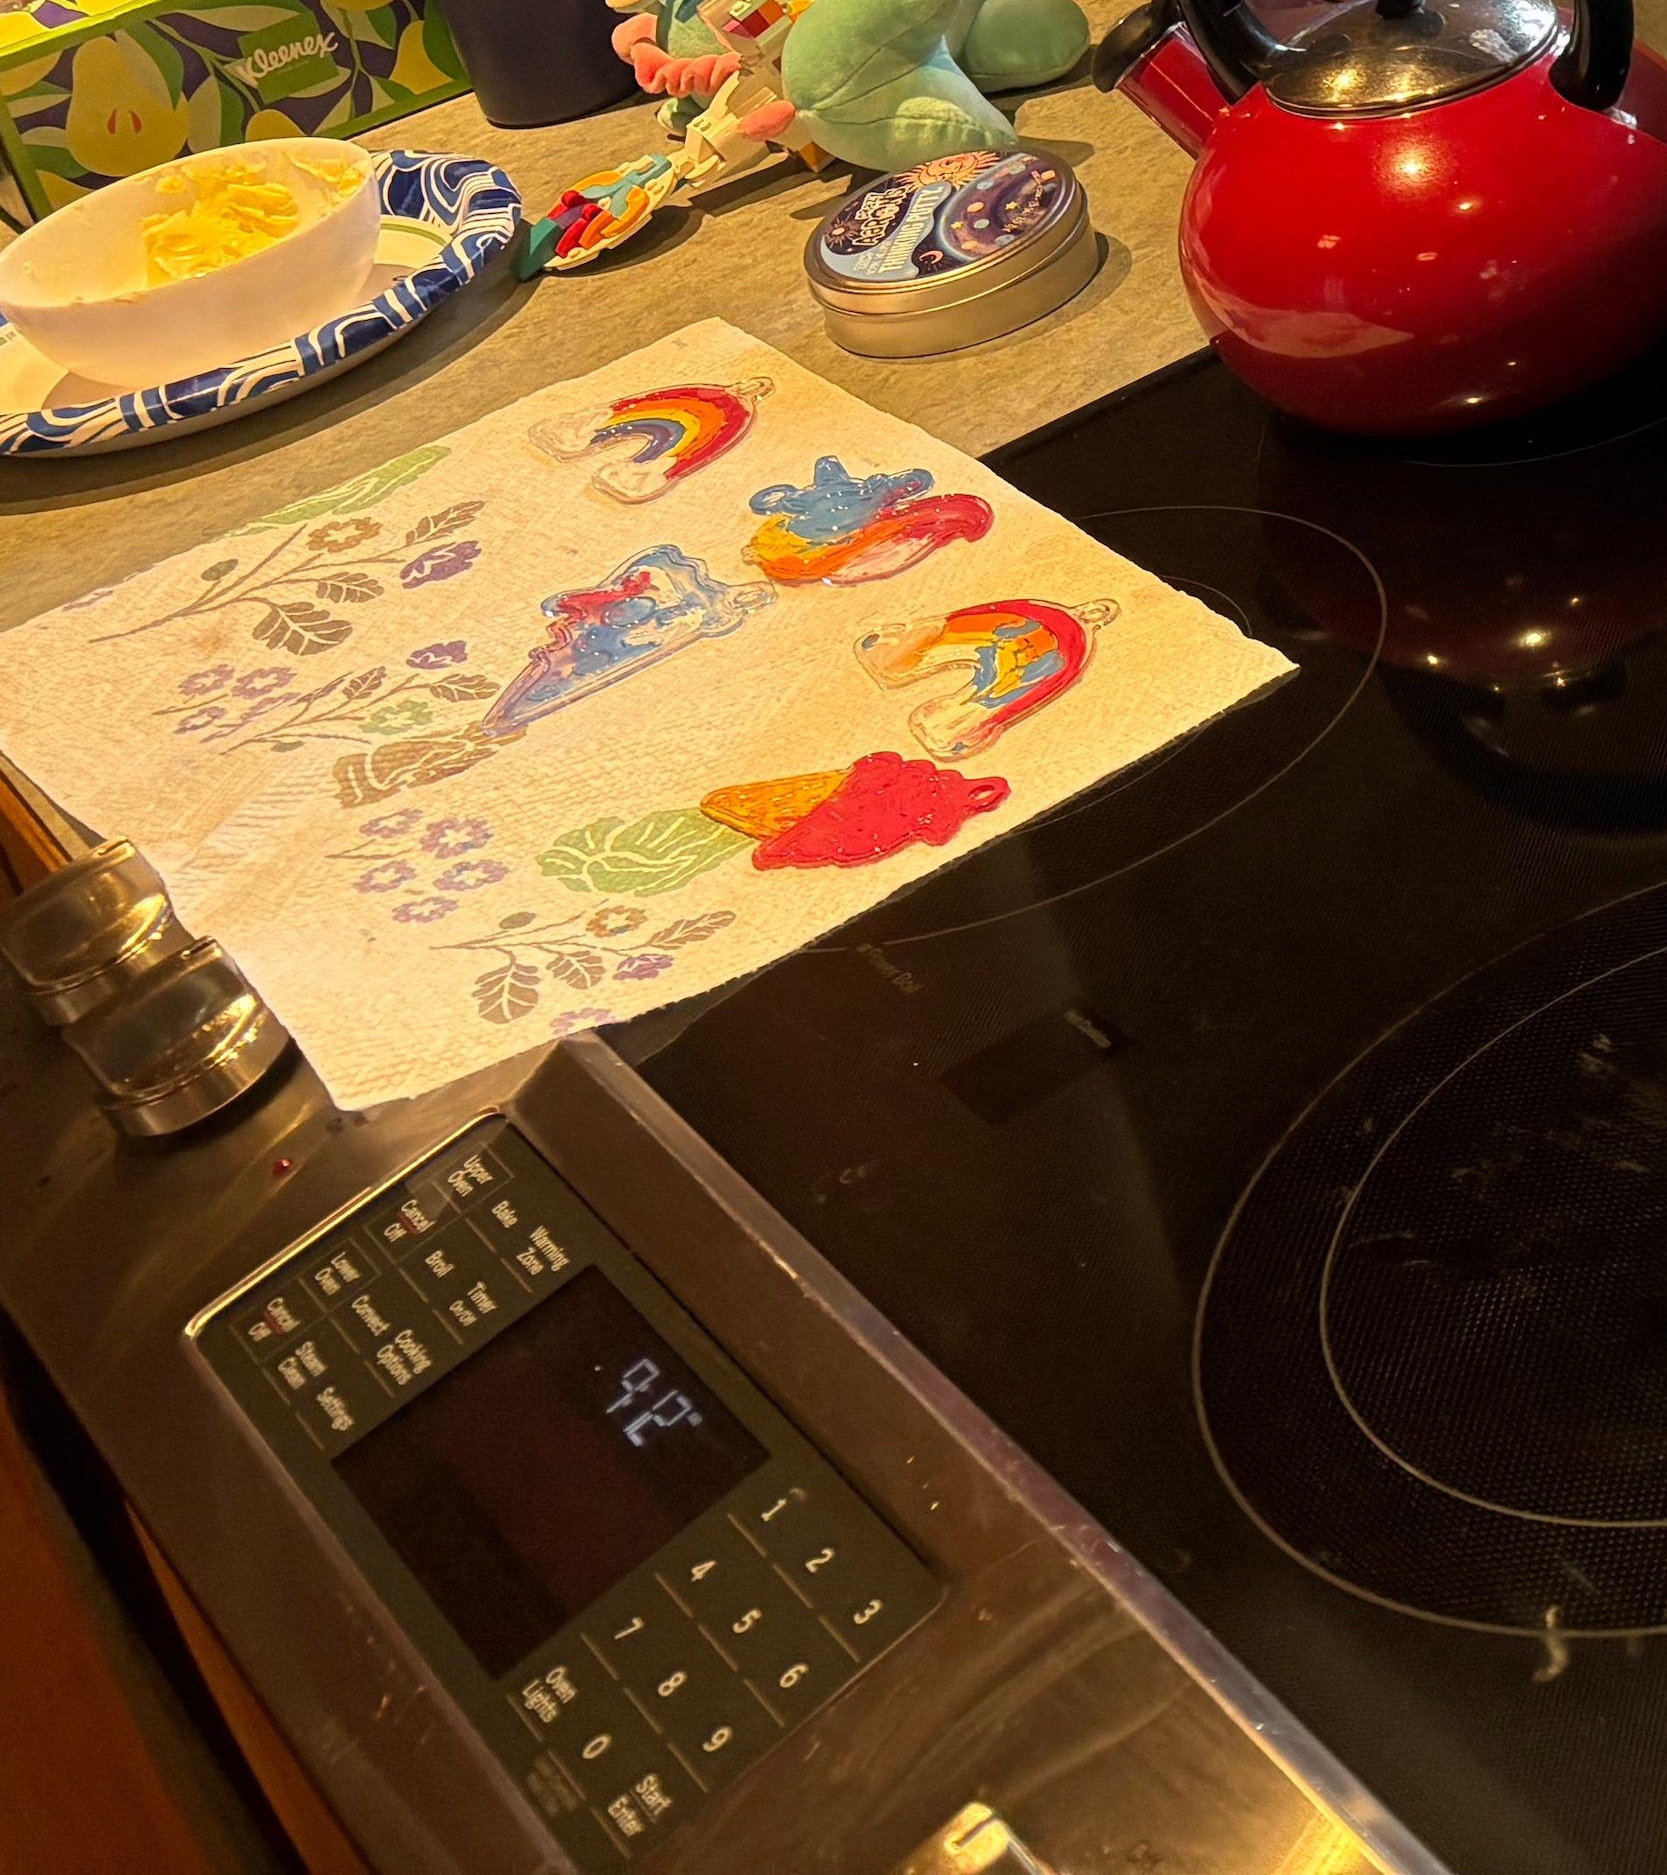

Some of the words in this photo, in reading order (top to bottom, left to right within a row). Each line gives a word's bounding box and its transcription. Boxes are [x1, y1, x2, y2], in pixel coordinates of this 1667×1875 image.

[235, 32, 339, 87] Kleenex
[878, 223, 925, 273] THINKING
[447, 1170, 474, 1197] Oven
[463, 1154, 493, 1184] Upper
[401, 1199, 436, 1233] Cancel
[491, 1200, 518, 1229] Bake
[383, 1222, 407, 1243] Off
[516, 1246, 544, 1275] Zone
[529, 1225, 571, 1272] Warming
[425, 1250, 455, 1278] Broil
[467, 1281, 497, 1314] Timer
[267, 1297, 300, 1333] Cancel
[377, 1344, 411, 1385] Options
[395, 1329, 432, 1375] Cooking
[316, 1386, 354, 1431] Settings
[761, 1498, 787, 1521] 1
[690, 1560, 717, 1582] 4
[805, 1547, 835, 1573] 2
[733, 1608, 762, 1633] 5
[853, 1599, 883, 1624] 3
[614, 1617, 644, 1640] 7
[545, 1666, 578, 1704] Oven
[658, 1671, 687, 1697] 8
[779, 1662, 809, 1688] 6
[522, 1679, 557, 1723] Lights
[582, 1734, 611, 1759] 0
[703, 1727, 733, 1752] 9
[635, 1774, 672, 1816] Start
[608, 1796, 644, 1837] Enter
